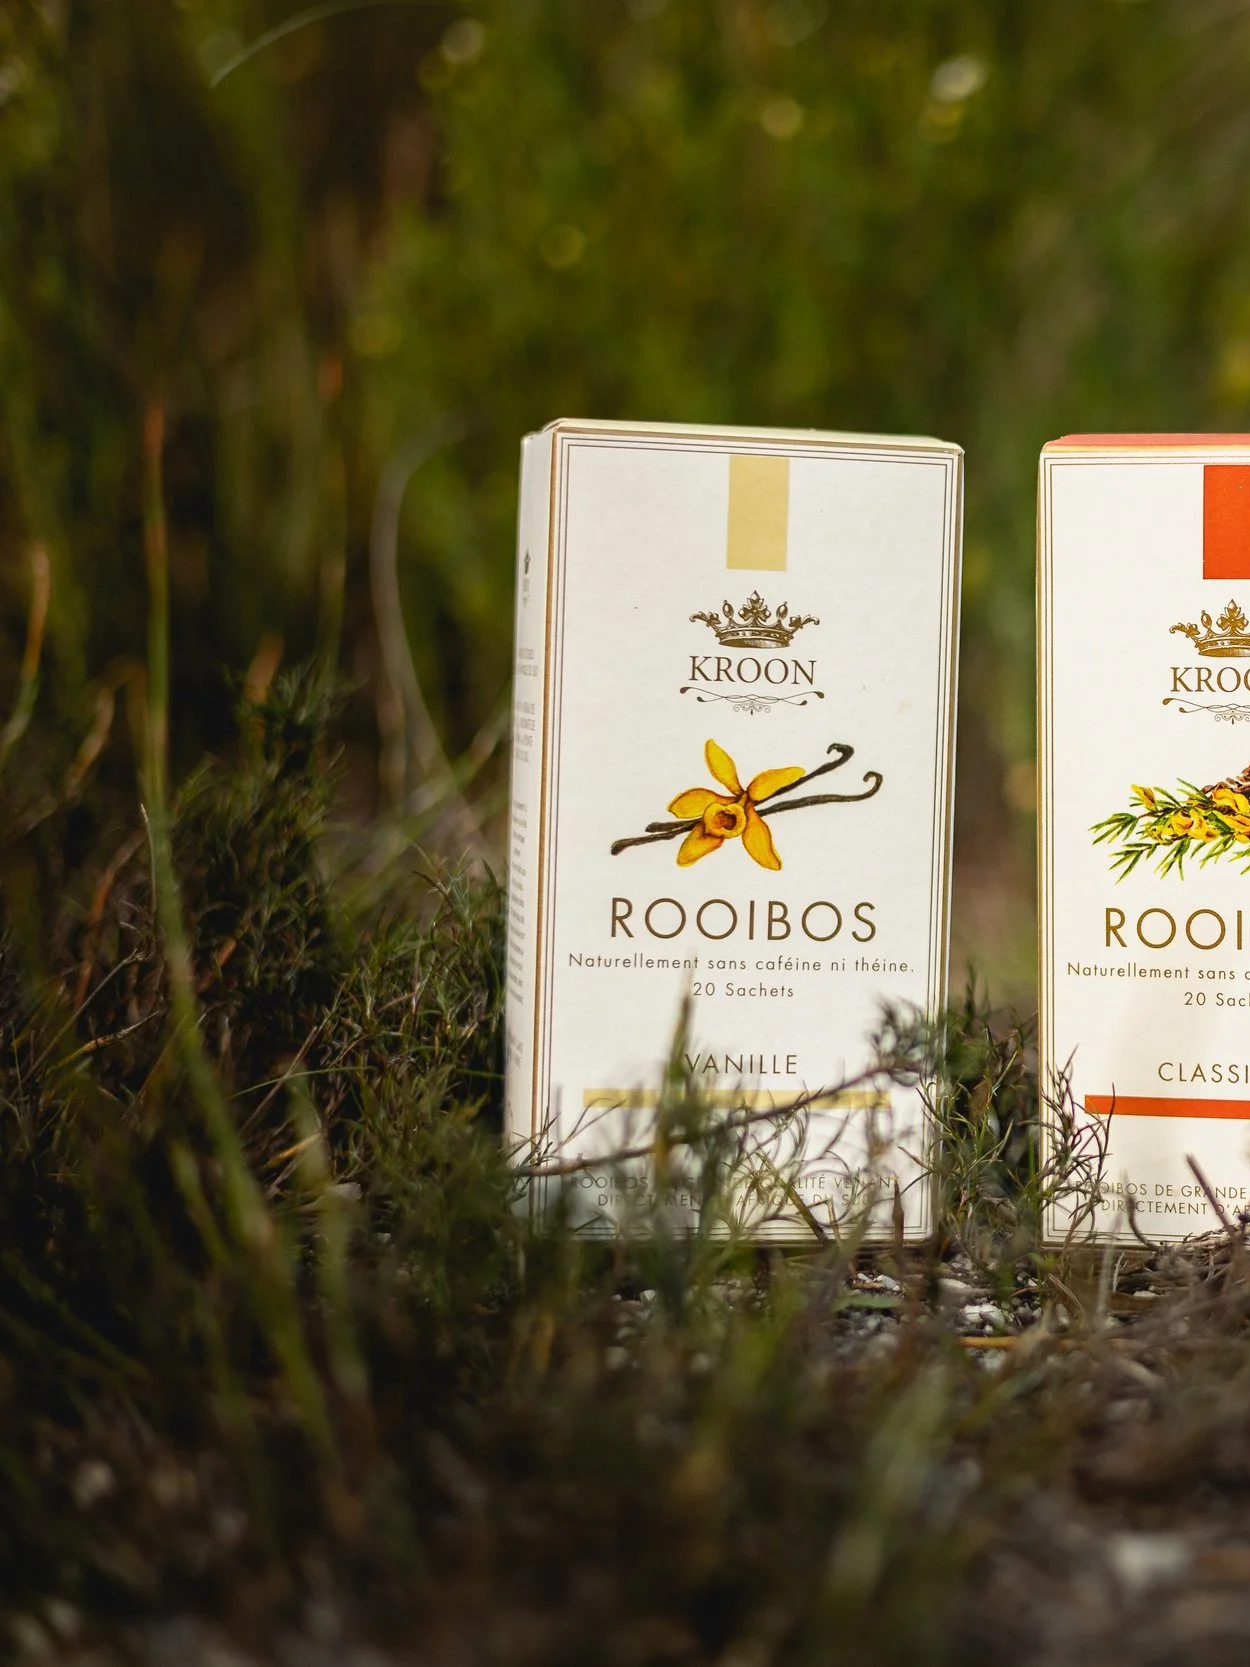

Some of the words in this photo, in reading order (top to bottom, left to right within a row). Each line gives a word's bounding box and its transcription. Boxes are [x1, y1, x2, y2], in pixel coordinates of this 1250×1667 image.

[688, 655, 818, 686] KROON
[610, 896, 877, 943] ROOIBOS
[568, 952, 699, 970] Naturellement
[707, 959, 747, 970] sans
[755, 954, 822, 971] caféine
[830, 958, 846, 972] ni
[854, 956, 914, 973] théine.
[1067, 961, 1190, 979] Naturellement
[1197, 969, 1236, 981] sans
[692, 981, 716, 997] 20
[725, 981, 794, 998] Sachets
[1184, 991, 1206, 1007] 20
[684, 1053, 798, 1075] VANILLE
[1155, 1183, 1173, 1197] DE
[1101, 1199, 1208, 1215] DIRCTEMENT
